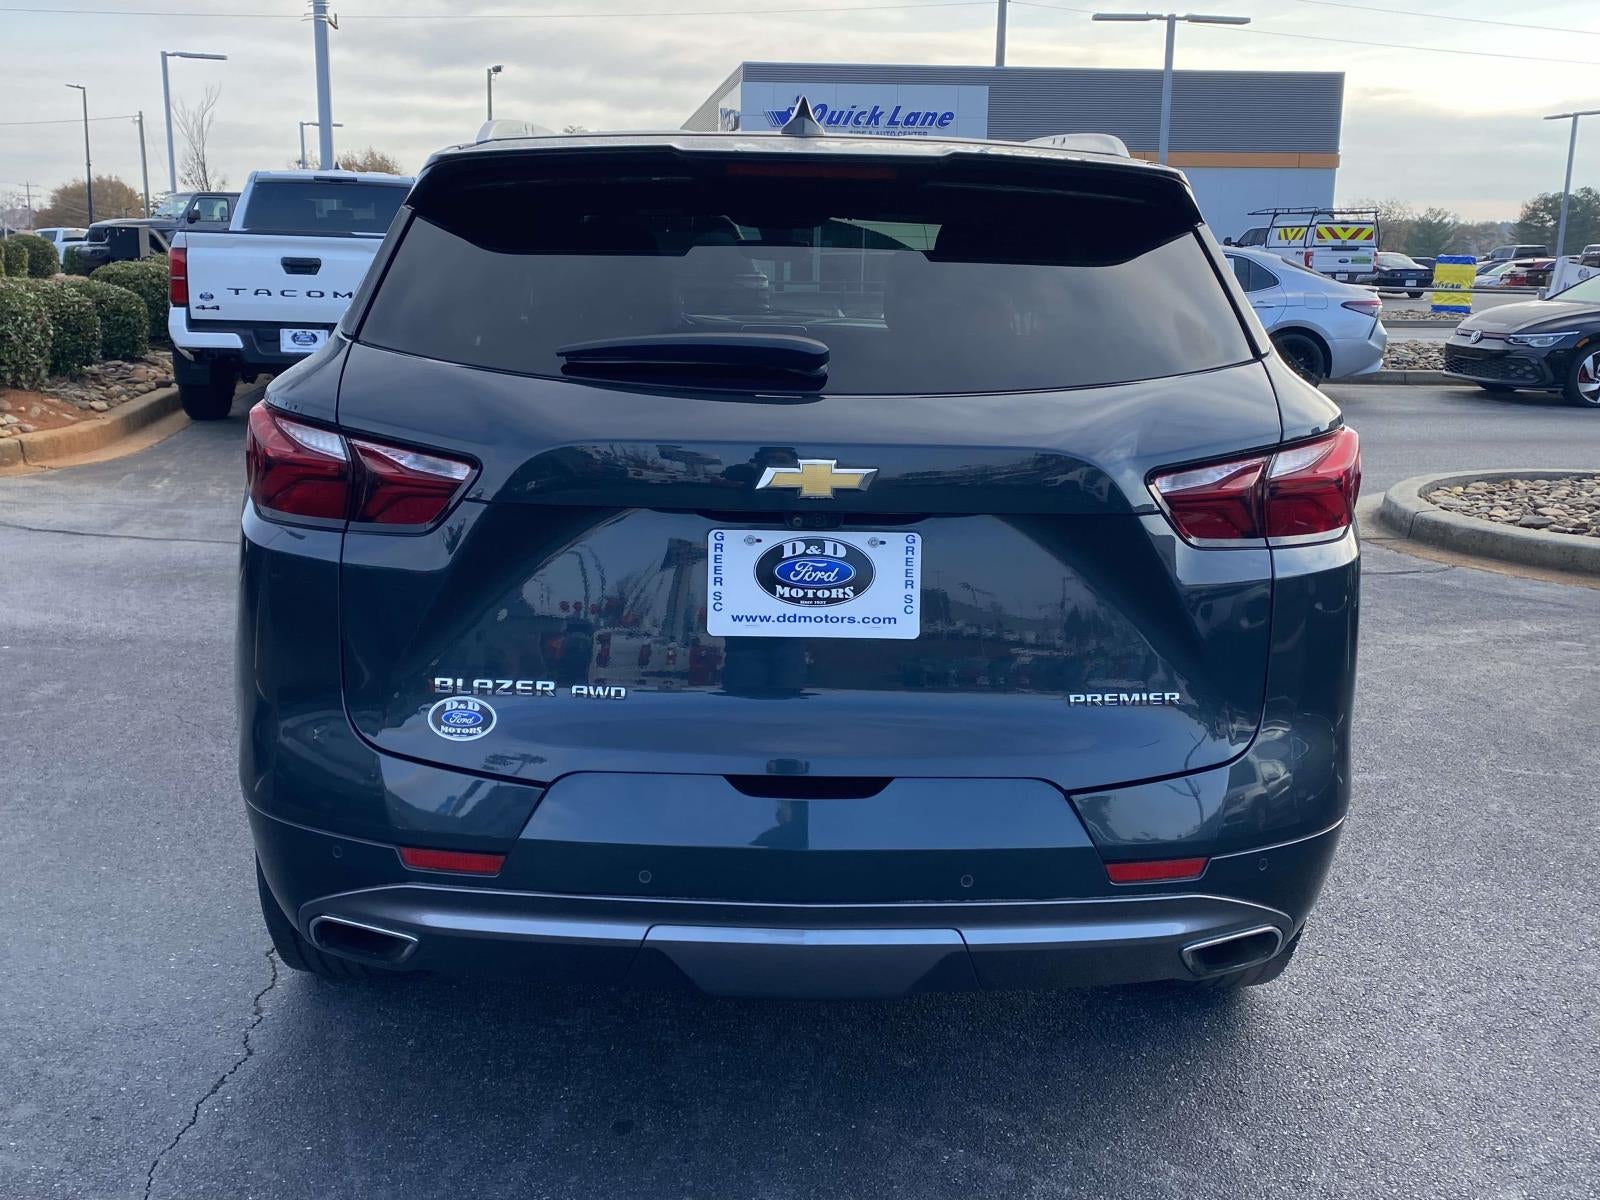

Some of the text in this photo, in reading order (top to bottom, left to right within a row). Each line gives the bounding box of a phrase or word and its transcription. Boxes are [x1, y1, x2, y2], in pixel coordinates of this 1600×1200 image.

[811, 103, 955, 128] Quick Lane
[713, 531, 725, 587] GREER
[781, 540, 847, 559] D&D
[790, 561, 840, 582] Ford
[904, 534, 916, 590] GREER
[713, 591, 723, 612] SC
[775, 585, 854, 599] MOTORS
[903, 594, 914, 615] SC
[730, 613, 897, 625] www.ddmotors.com
[434, 677, 626, 700] BLAZER AWD
[445, 700, 480, 712] D&D
[1068, 692, 1181, 706] PREMIER
[449, 712, 475, 724] Ford
[440, 725, 483, 735] MOTORS
